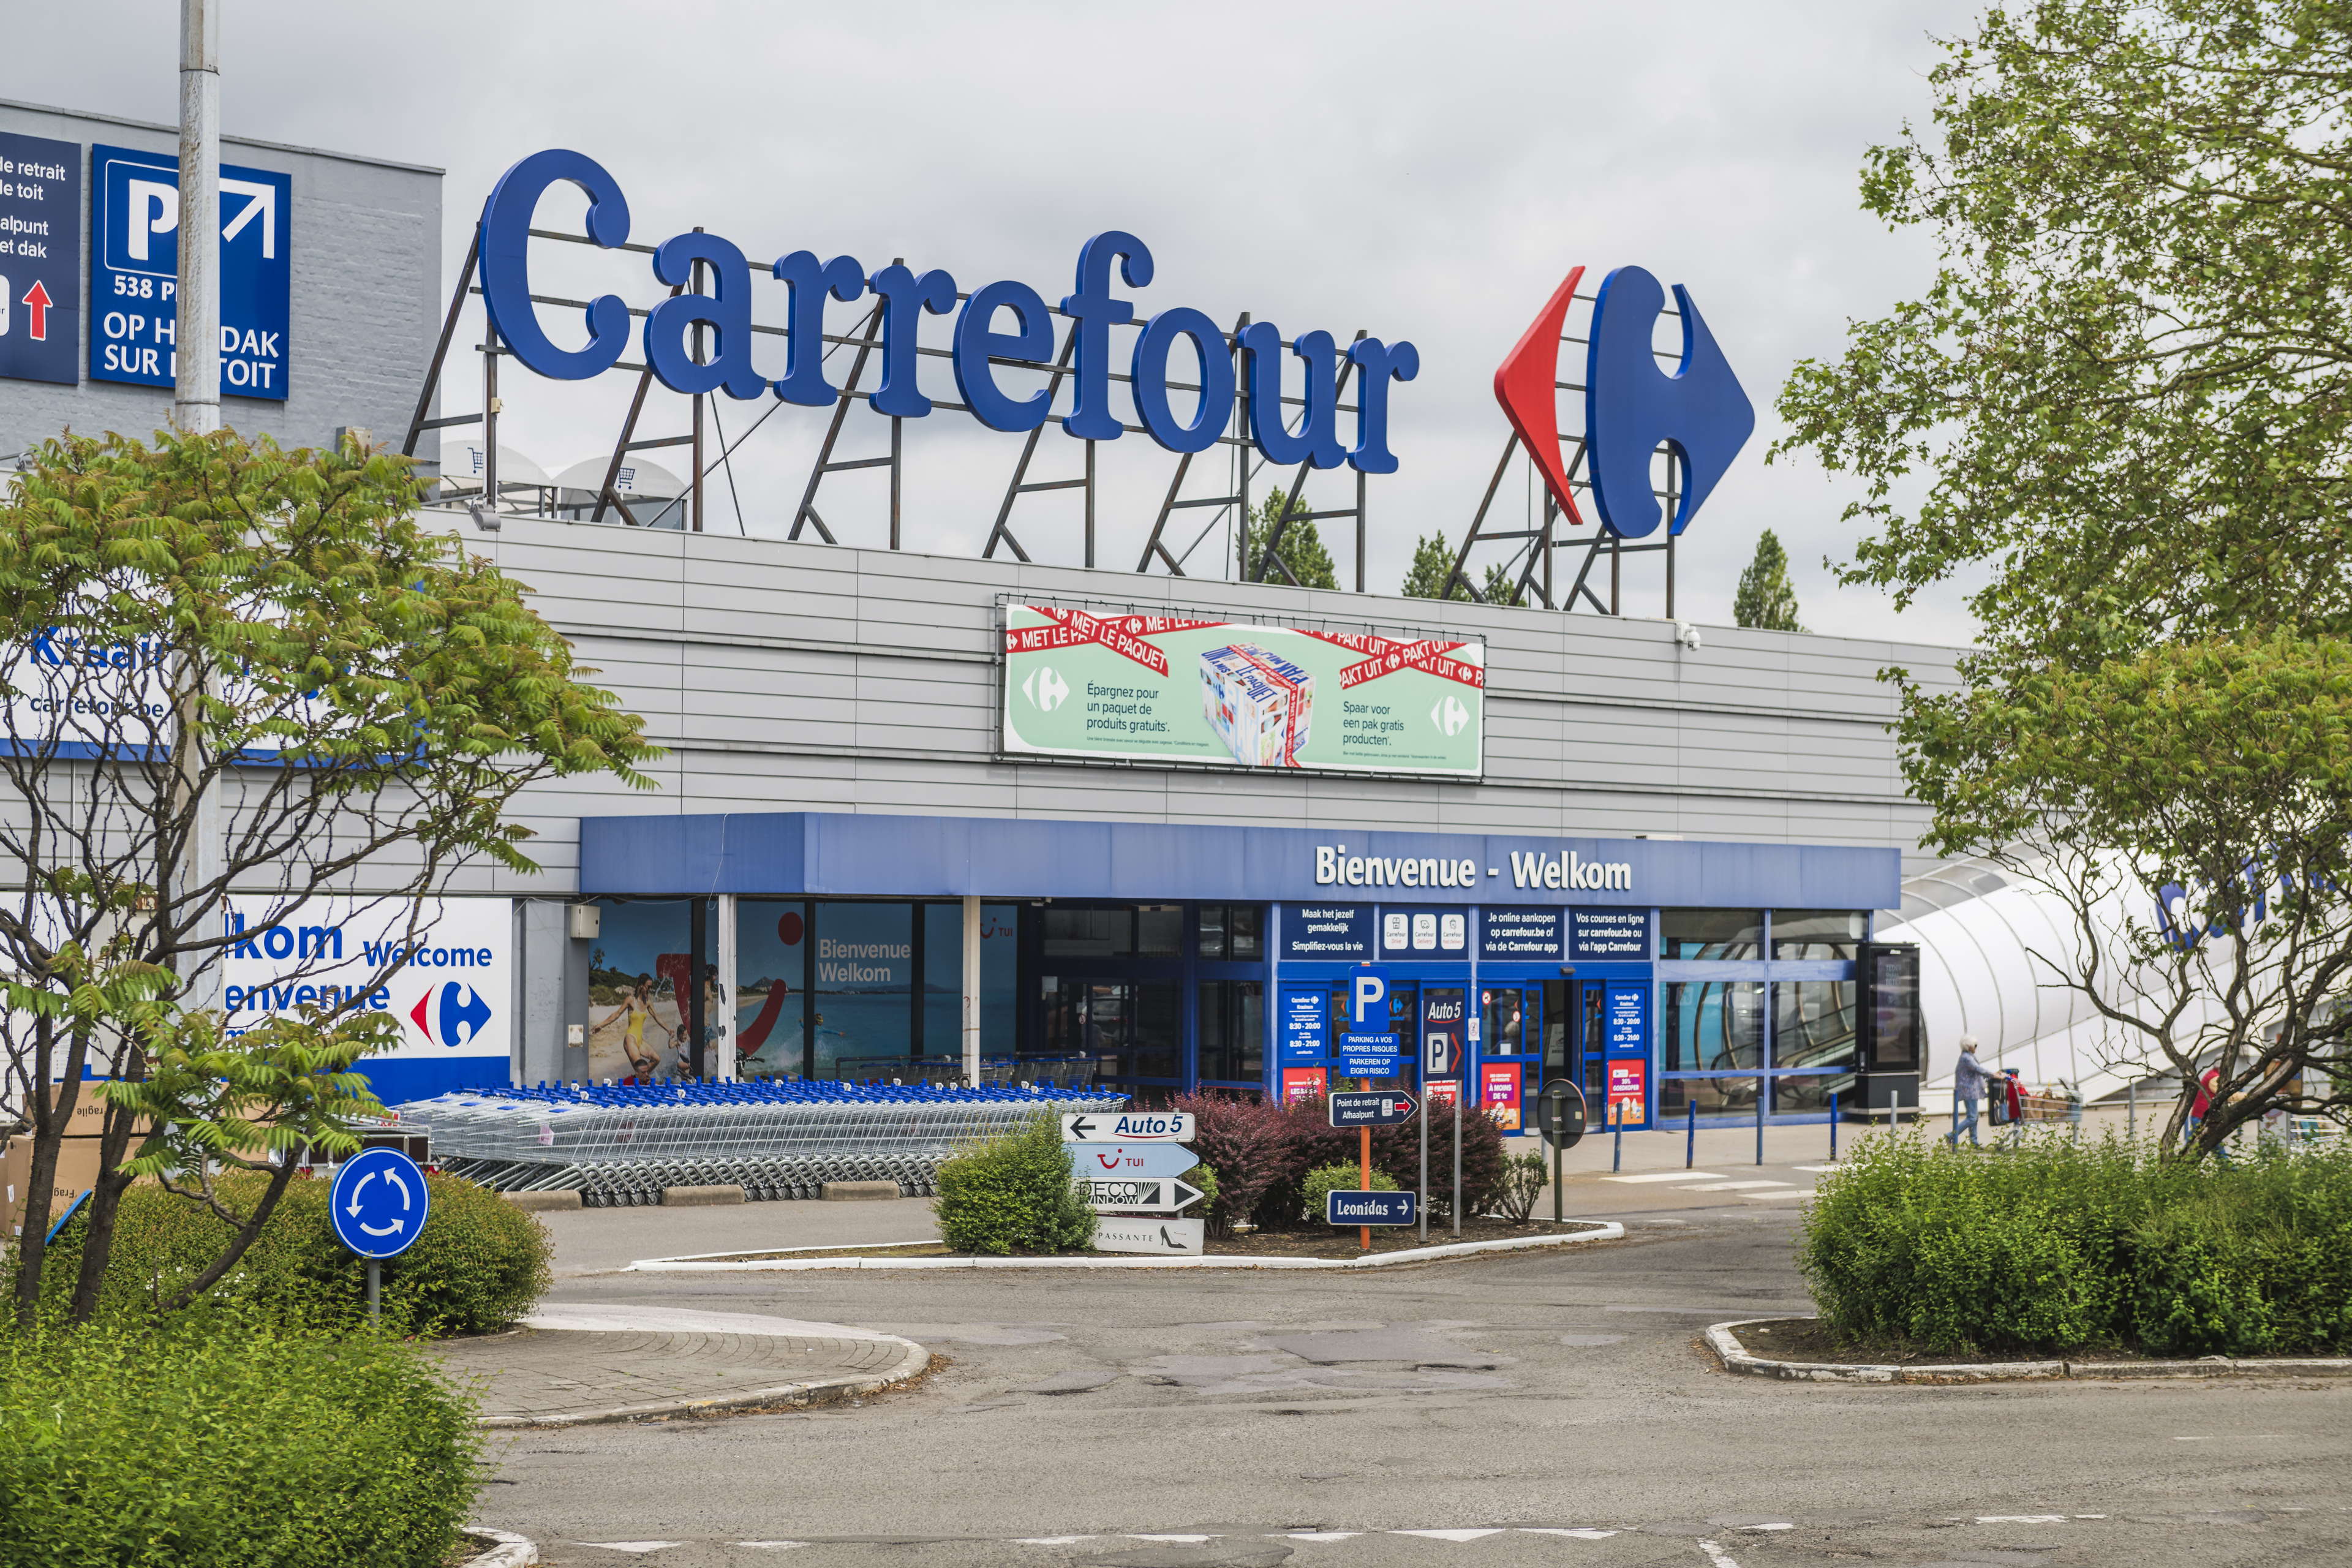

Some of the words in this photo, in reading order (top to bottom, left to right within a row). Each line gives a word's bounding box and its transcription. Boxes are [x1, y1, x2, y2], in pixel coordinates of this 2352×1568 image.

[18, 162, 66, 181] retrait
[17, 182, 43, 201] toit
[18, 241, 47, 258] dak
[113, 274, 153, 299] 538
[479, 148, 1419, 474] Carrefour
[104, 311, 145, 341] OP
[220, 325, 279, 358] DAK
[104, 344, 160, 377] SUR
[1021, 630, 1048, 649] MET
[1052, 627, 1068, 646] LE
[1071, 611, 1099, 637] MET
[1099, 625, 1115, 647] LE
[1117, 634, 1167, 670] PAQUET
[1337, 632, 1368, 650] PAKT
[1368, 638, 1388, 655] UIT
[1402, 641, 1431, 664] PAKT
[1363, 658, 1382, 679] UIT
[1436, 658, 1457, 677] UIT
[1087, 680, 1134, 699] Épargnez
[1136, 687, 1159, 701] pour
[1243, 674, 1278, 703] PAQUET
[1087, 703, 1100, 712] un
[1102, 703, 1138, 716] paquet
[1139, 703, 1152, 715] de
[1343, 701, 1369, 715] Spaar
[1371, 705, 1391, 715] voor
[1087, 717, 1128, 731] produits
[1343, 719, 1360, 729] een
[1362, 718, 1378, 731] pak
[1380, 720, 1404, 733] gratis
[1315, 844, 1476, 888] Bienvenue
[1510, 850, 1632, 890] Welkom
[1302, 909, 1321, 919] Maak
[1322, 909, 1335, 919] het
[1334, 910, 1354, 921] jezelf
[1488, 912, 1497, 923] Je
[1498, 913, 1520, 923] online
[1521, 913, 1556, 924] aankopen
[1575, 913, 1589, 923] Vos
[1590, 915, 1616, 924] courses
[1618, 915, 1627, 924] en
[1627, 914, 1645, 925] ligne
[998, 927, 1013, 937] TUI
[1307, 922, 1349, 934] gemakkelijk
[1490, 929, 1500, 938] op
[1501, 927, 1545, 937] carrefour.be
[1546, 927, 1554, 937] of
[1590, 928, 1632, 938] carrefour.be
[363, 940, 492, 967] Welcome
[820, 938, 911, 959] Bienvenue
[1292, 941, 1344, 952] Simplifiez-vous
[1345, 941, 1353, 951] la
[1353, 941, 1363, 951] vie
[1485, 941, 1496, 951] via
[1498, 941, 1507, 951] de
[1509, 941, 1543, 952] Carrefour
[1544, 943, 1558, 953] app
[1578, 942, 1589, 951] via
[1608, 942, 1642, 952] Carrefour
[818, 962, 891, 982] Welkom
[1355, 976, 1384, 1022] P
[1427, 1001, 1453, 1019] Auto
[1453, 1001, 1461, 1018] 5
[1432, 1039, 1444, 1068] P
[1493, 1084, 1512, 1092] MOINS
[1336, 1098, 1353, 1107] Point
[1353, 1098, 1362, 1107] de
[1362, 1098, 1380, 1106] retrait
[1342, 1110, 1374, 1121] Afhaalpunt
[1114, 1116, 1166, 1134] Auto
[1169, 1115, 1183, 1133] 5
[1125, 1158, 1144, 1167] TUI
[1079, 1182, 1137, 1196] DECO
[1336, 1199, 1389, 1216] Leonidas
[1098, 1232, 1153, 1242] PASSANTE
